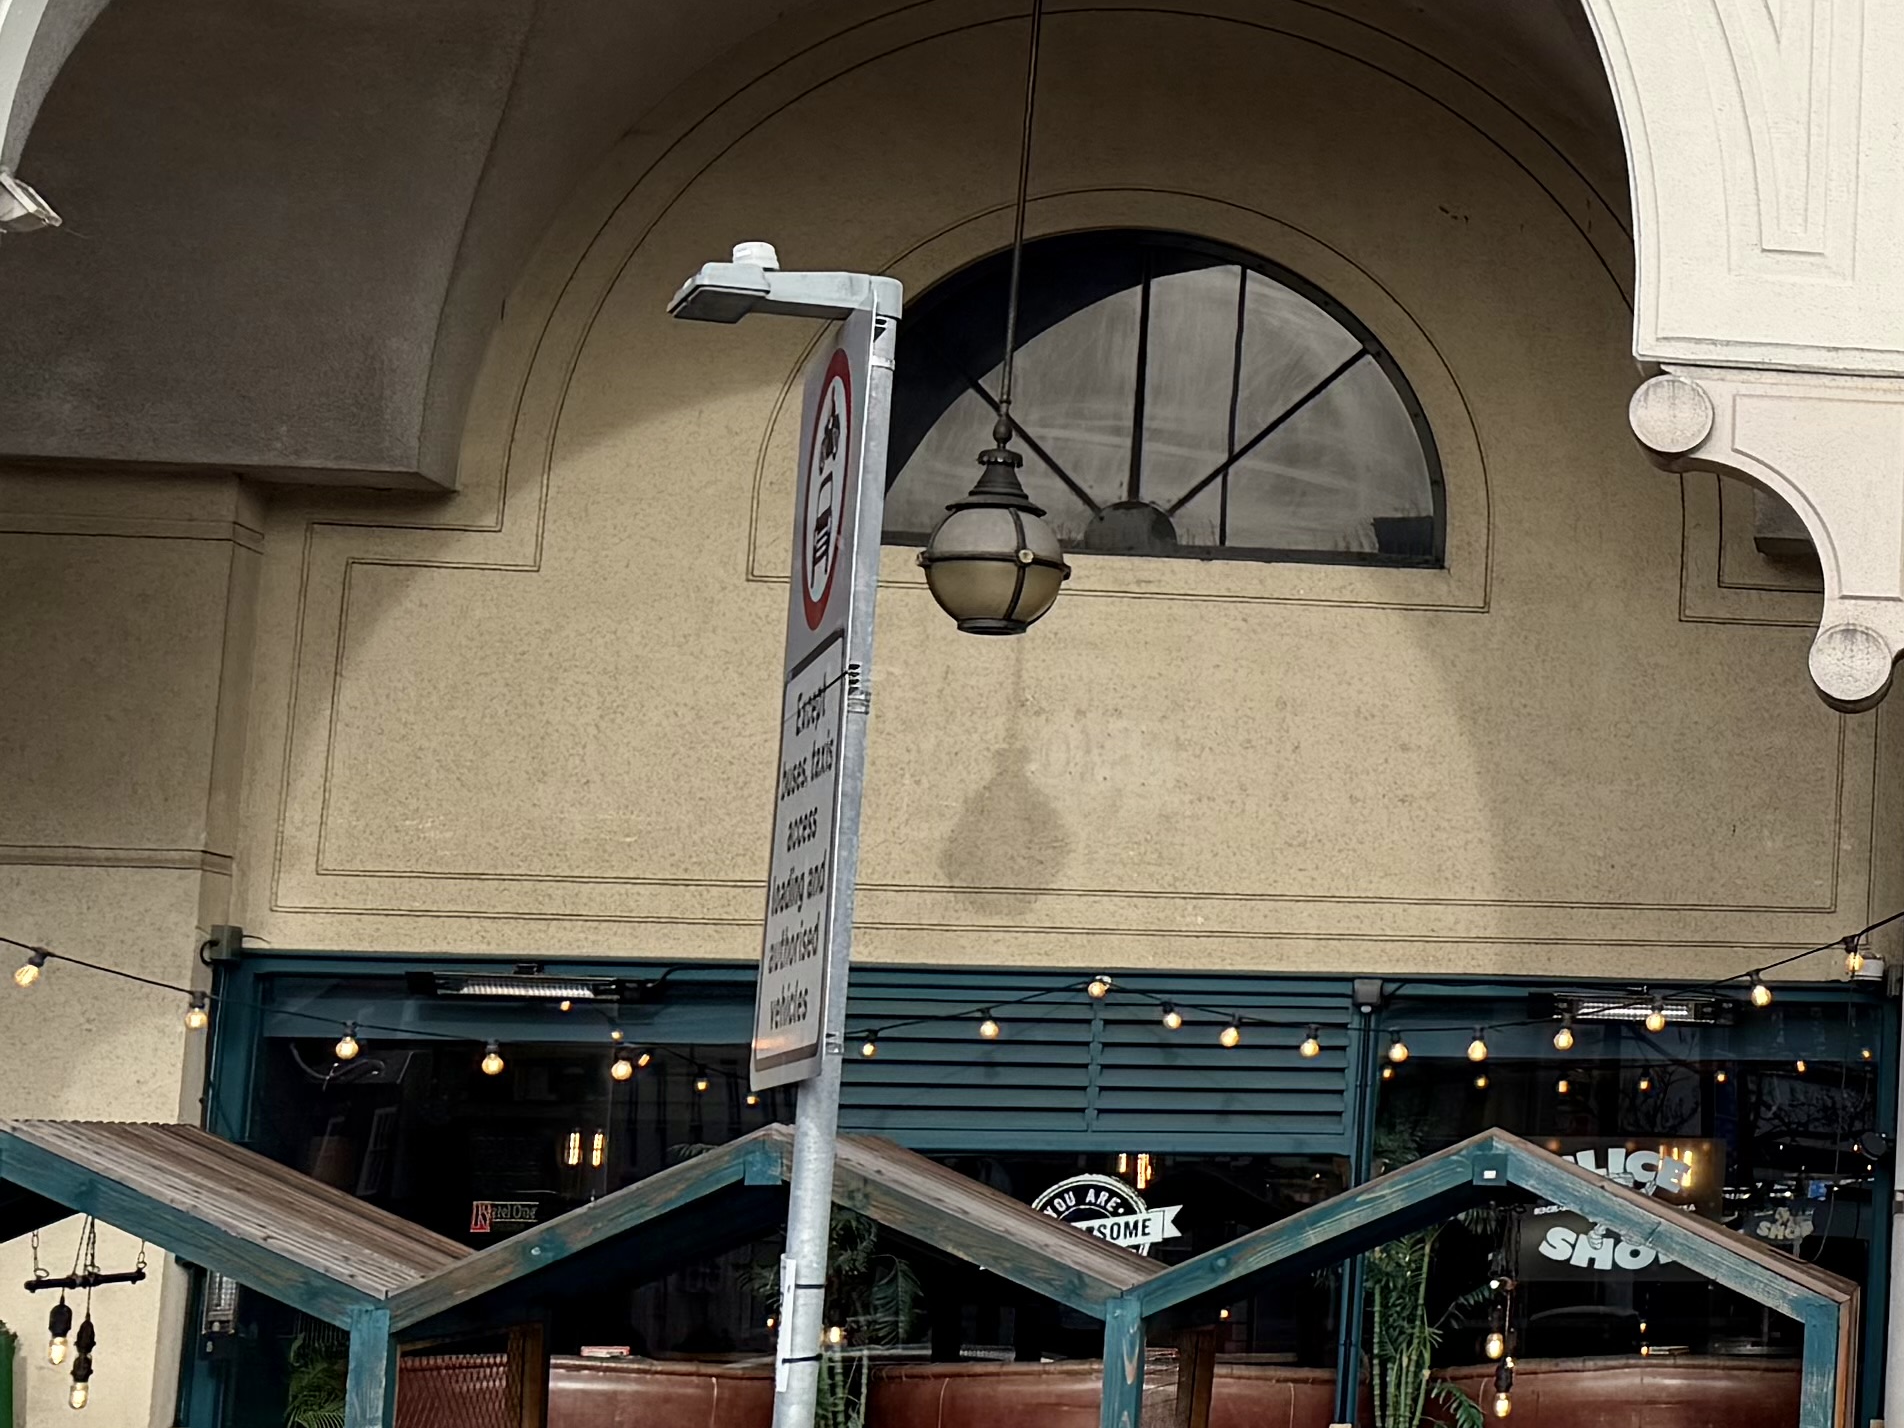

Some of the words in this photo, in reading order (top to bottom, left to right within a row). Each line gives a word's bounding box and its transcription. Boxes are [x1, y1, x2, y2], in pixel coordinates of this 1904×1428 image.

[795, 672, 827, 737] Except
[811, 729, 834, 782] taxis
[787, 806, 818, 853] access
[771, 866, 805, 917] loading
[806, 848, 827, 900] and
[769, 910, 820, 974] authorised
[770, 979, 808, 1031] vehicles
[1085, 1188, 1122, 1212] ARE
